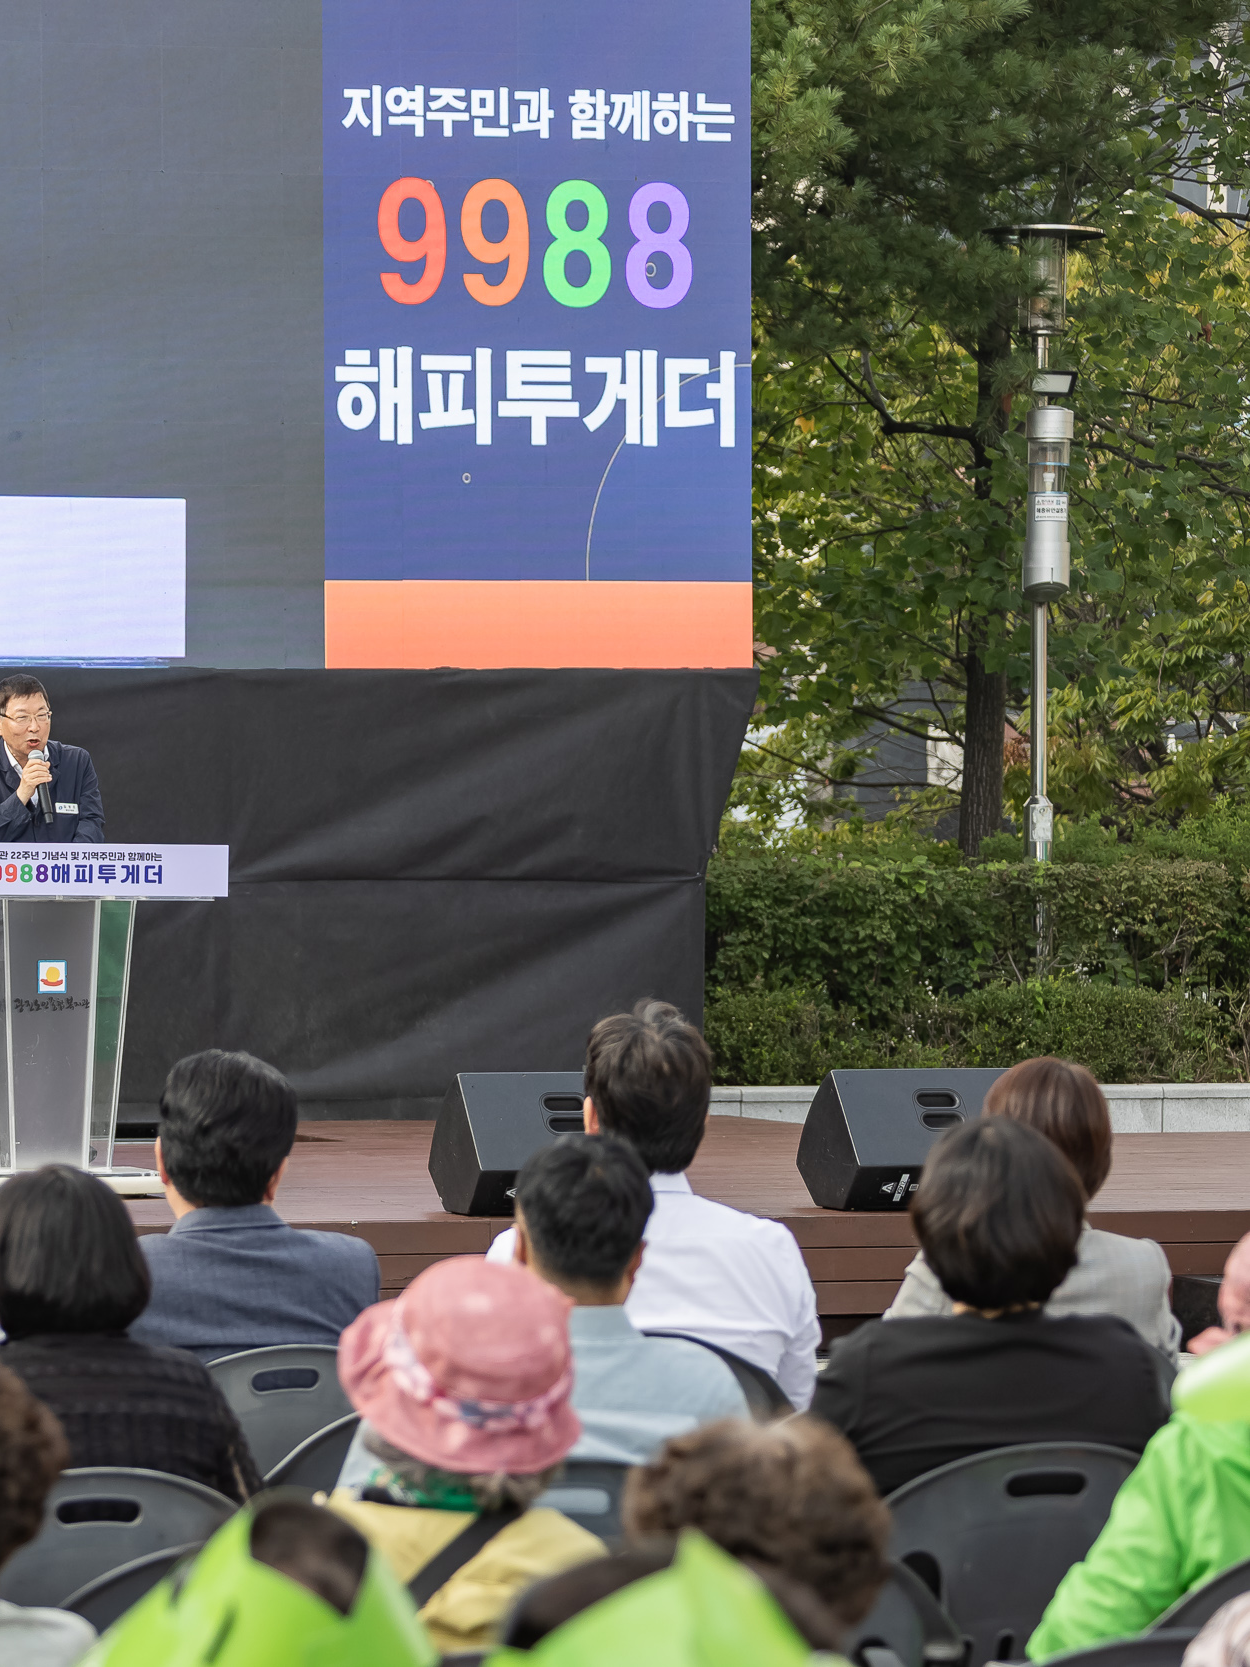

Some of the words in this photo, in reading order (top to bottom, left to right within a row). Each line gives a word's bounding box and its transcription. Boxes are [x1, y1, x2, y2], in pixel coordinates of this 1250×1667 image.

[342, 84, 555, 139] 지역주민과
[568, 88, 736, 142] 함께하는
[377, 176, 693, 309] 9988
[334, 346, 737, 448] 해피투게더
[10, 851, 40, 860] 22주년
[41, 851, 68, 861] 기념식
[70, 851, 80, 861] 및
[81, 851, 126, 861] 지역주민과
[127, 852, 163, 862] 함께하는
